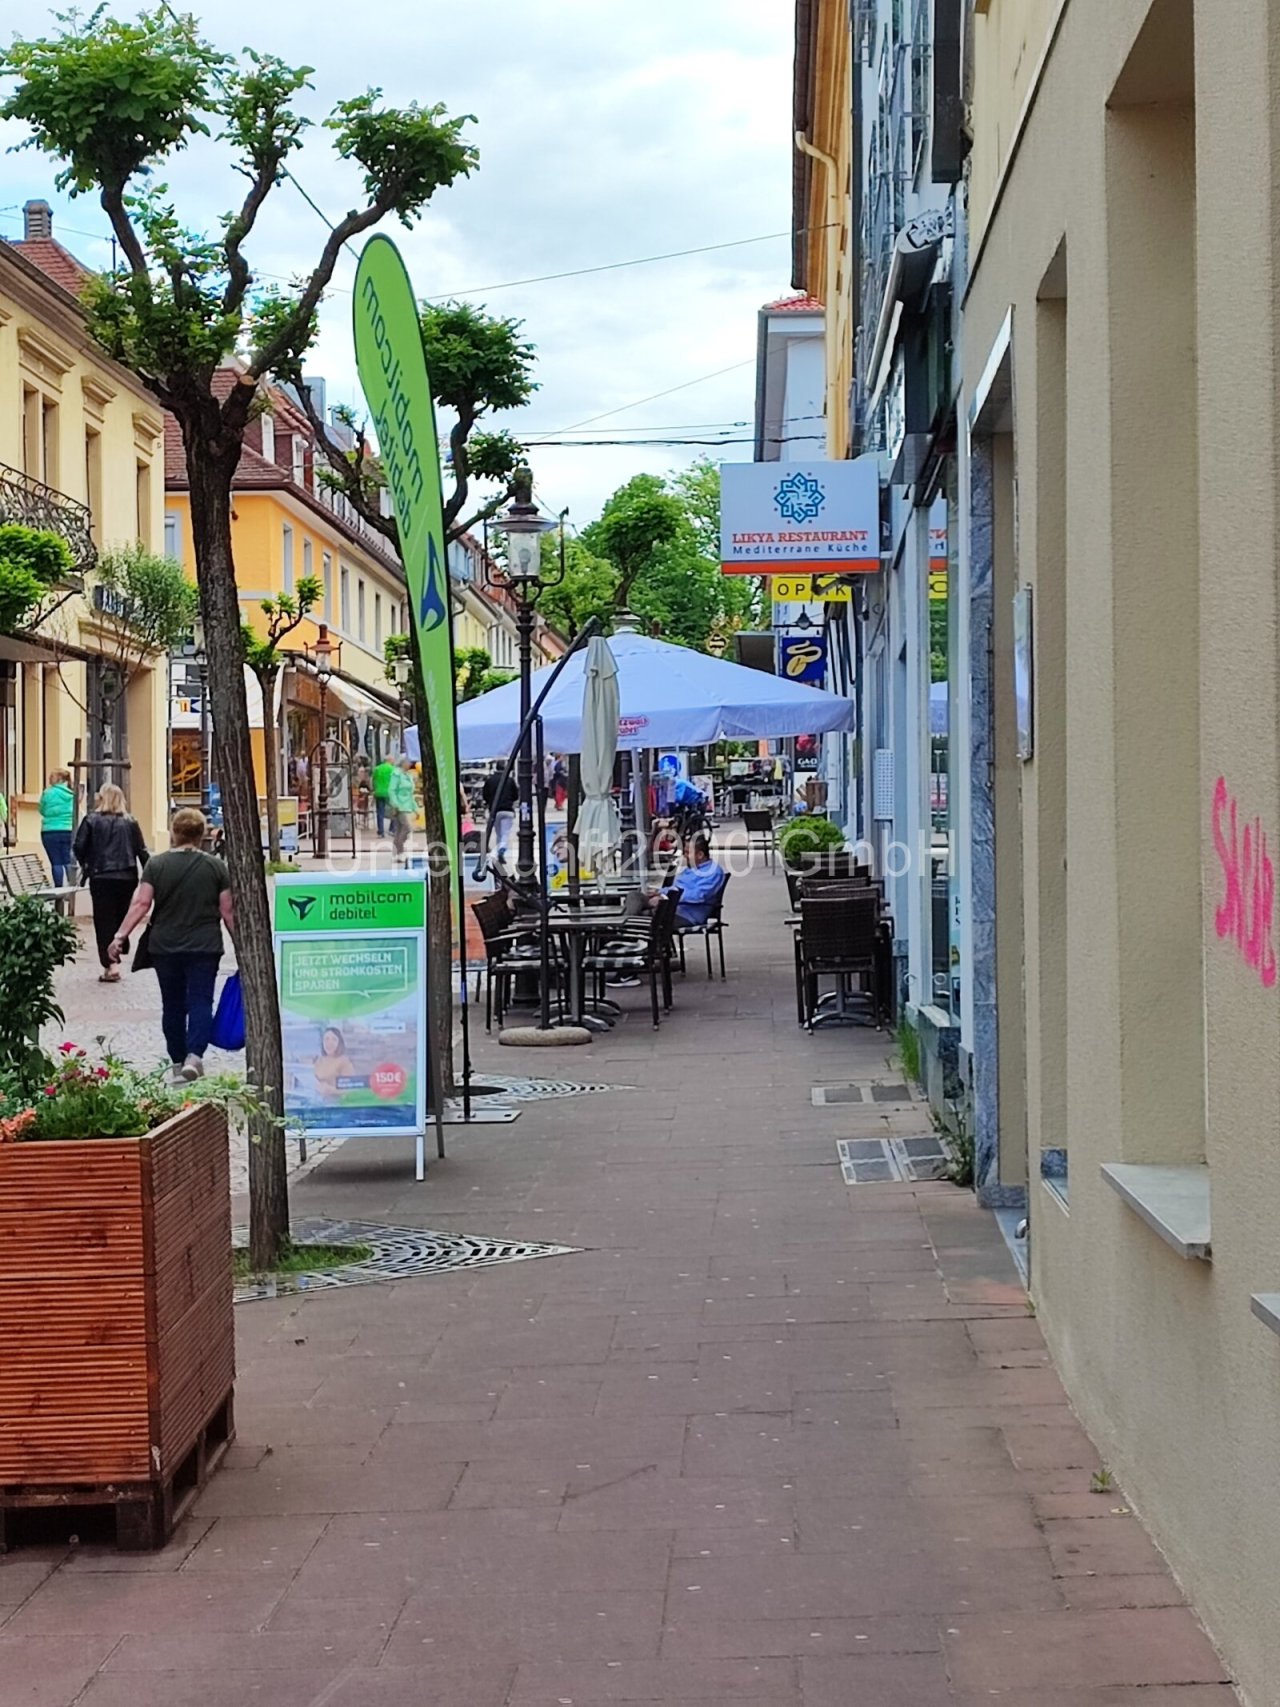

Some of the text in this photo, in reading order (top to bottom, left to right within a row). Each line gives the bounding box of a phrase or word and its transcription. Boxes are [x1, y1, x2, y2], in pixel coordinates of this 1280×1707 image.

[732, 530, 868, 544] LIKYA RESTAURANT
[733, 543, 868, 555] Mediterrane Küche
[777, 583, 846, 596] OPK
[329, 890, 413, 905] mobilcom
[329, 906, 377, 921] debitel
[295, 952, 392, 967] JETZT WECHSELN
[295, 964, 403, 979] UND STROMKOSTEN
[295, 979, 340, 992] SPAREN
